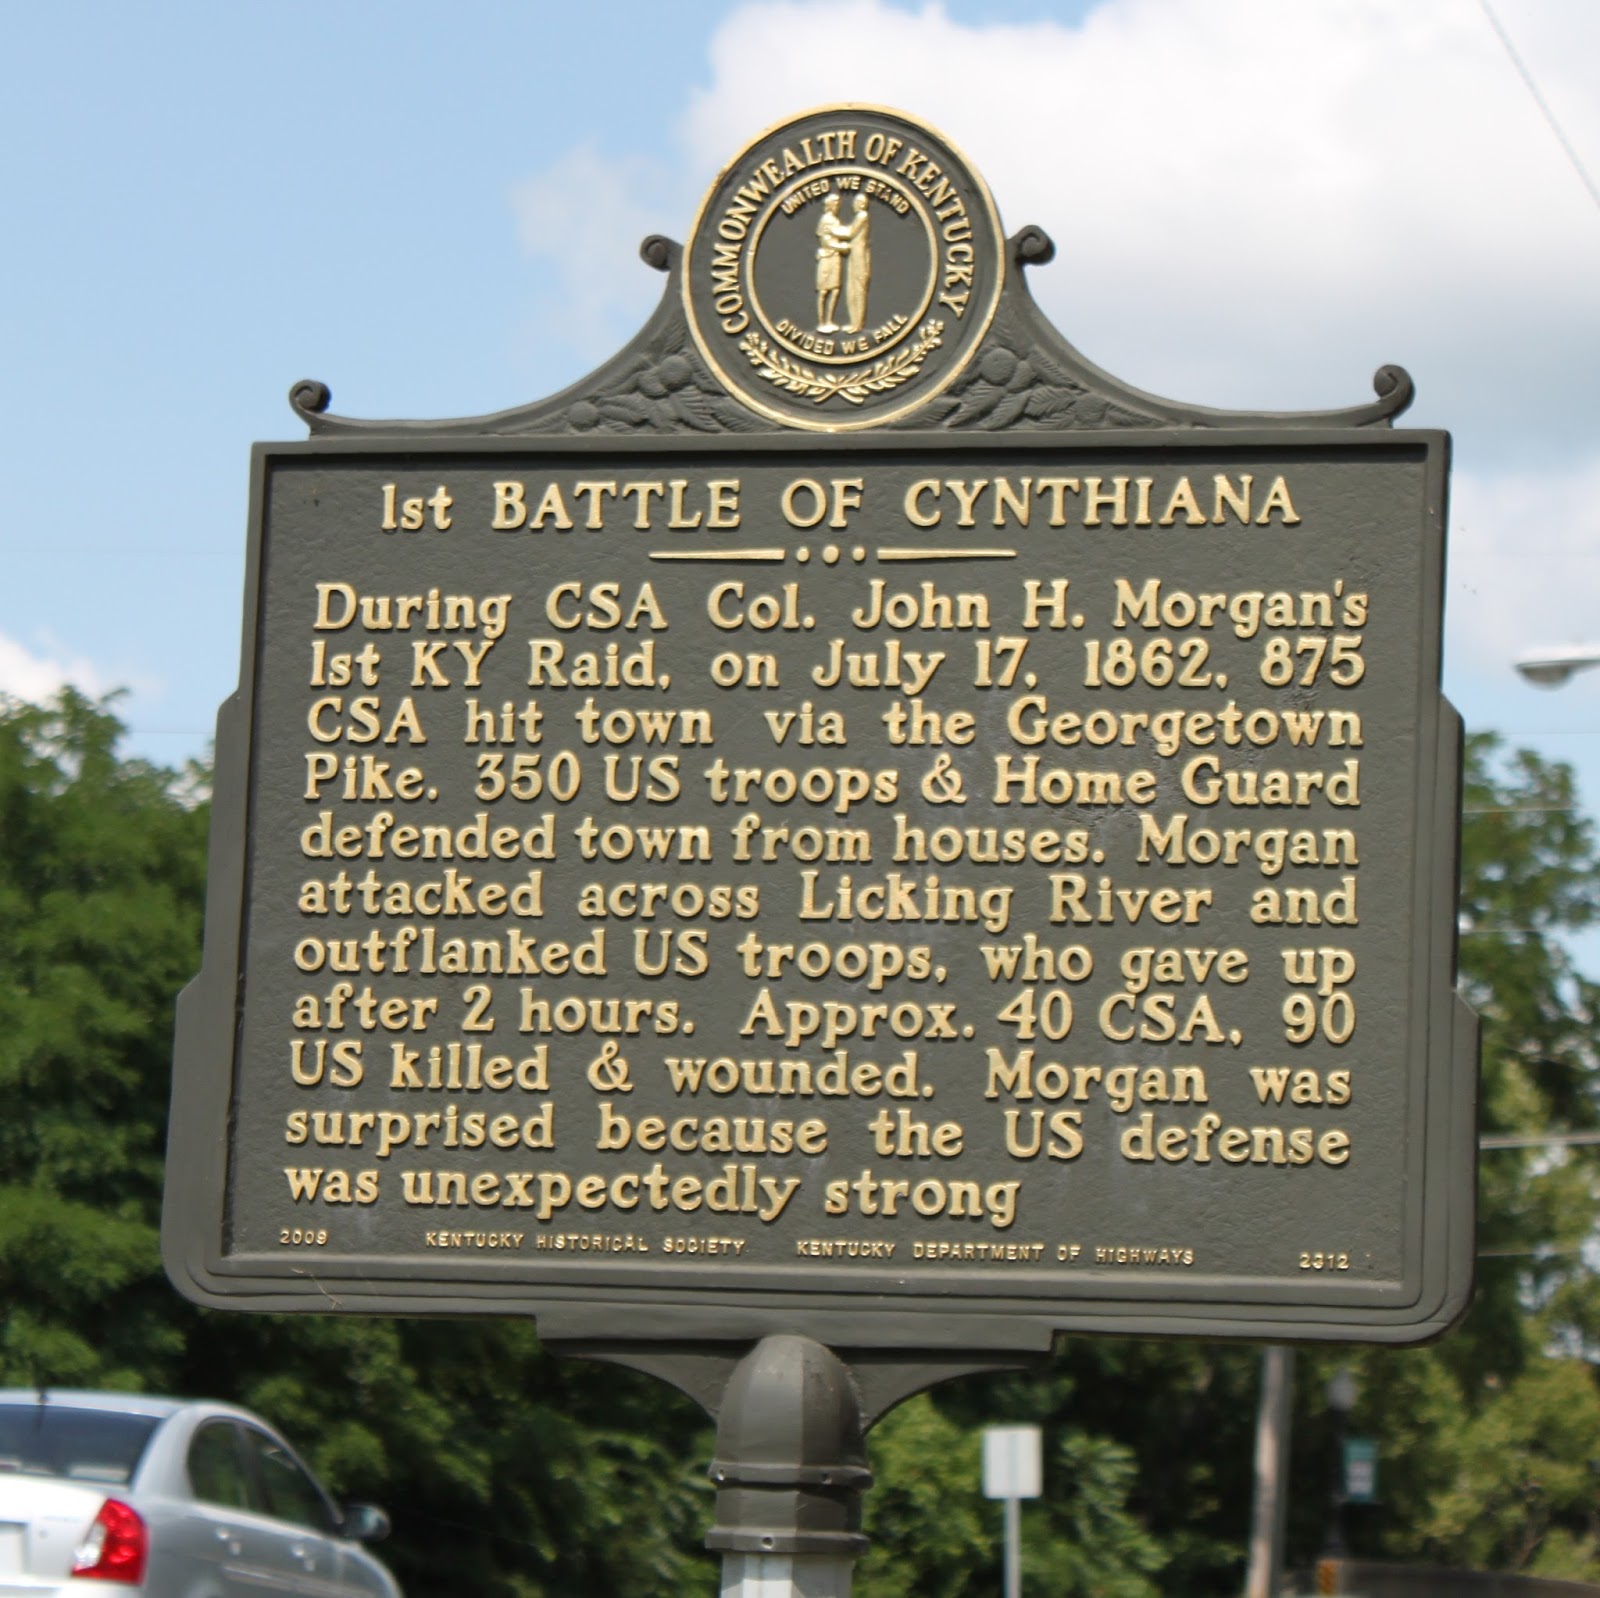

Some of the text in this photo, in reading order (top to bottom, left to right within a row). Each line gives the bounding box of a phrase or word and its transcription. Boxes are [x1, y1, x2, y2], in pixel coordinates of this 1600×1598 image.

[781, 177, 911, 215] UNITED WE STAND
[711, 130, 975, 334] COMMONWEALTH OF KENTUCKY
[775, 313, 909, 355] DIVIDED WE FALL
[491, 477, 741, 529] BATTLE
[780, 476, 864, 528] OF
[903, 472, 1301, 527] CYNTHIANA
[312, 576, 1369, 640] During CSA Col. John H. Morgan's
[411, 639, 495, 687] KY
[527, 637, 671, 690] Raid,
[710, 650, 780, 687] on
[810, 637, 947, 696] July
[974, 634, 1038, 688] 17,
[1083, 635, 1228, 689] 1862,
[1259, 633, 1365, 686] 875
[307, 693, 1364, 757] CSA hit town via the Georgetown
[303, 749, 1361, 814] Pike. 350 US troops & Home Guard
[300, 809, 1360, 875] defended town from houses. Morgan
[297, 866, 1359, 933] attacked across Licking River and
[294, 924, 1356, 997] outflanked US troops, who gave up
[292, 979, 1356, 1049] after 2 hours. Approx. 40 CSA, 90
[290, 1038, 1351, 1113] US killed & wounded. Morgan was
[285, 1100, 1350, 1164] surprised because the US defense
[283, 1161, 1021, 1228] was unexpectedly strong
[279, 1228, 328, 1245] 2009
[425, 1230, 746, 1254] KENTUCKY HISTORICAL SOCIETY
[796, 1238, 1194, 1265] KENTUCKY DEPARTMENT OF HIGHWAYS
[1299, 1251, 1350, 1269] 2312
